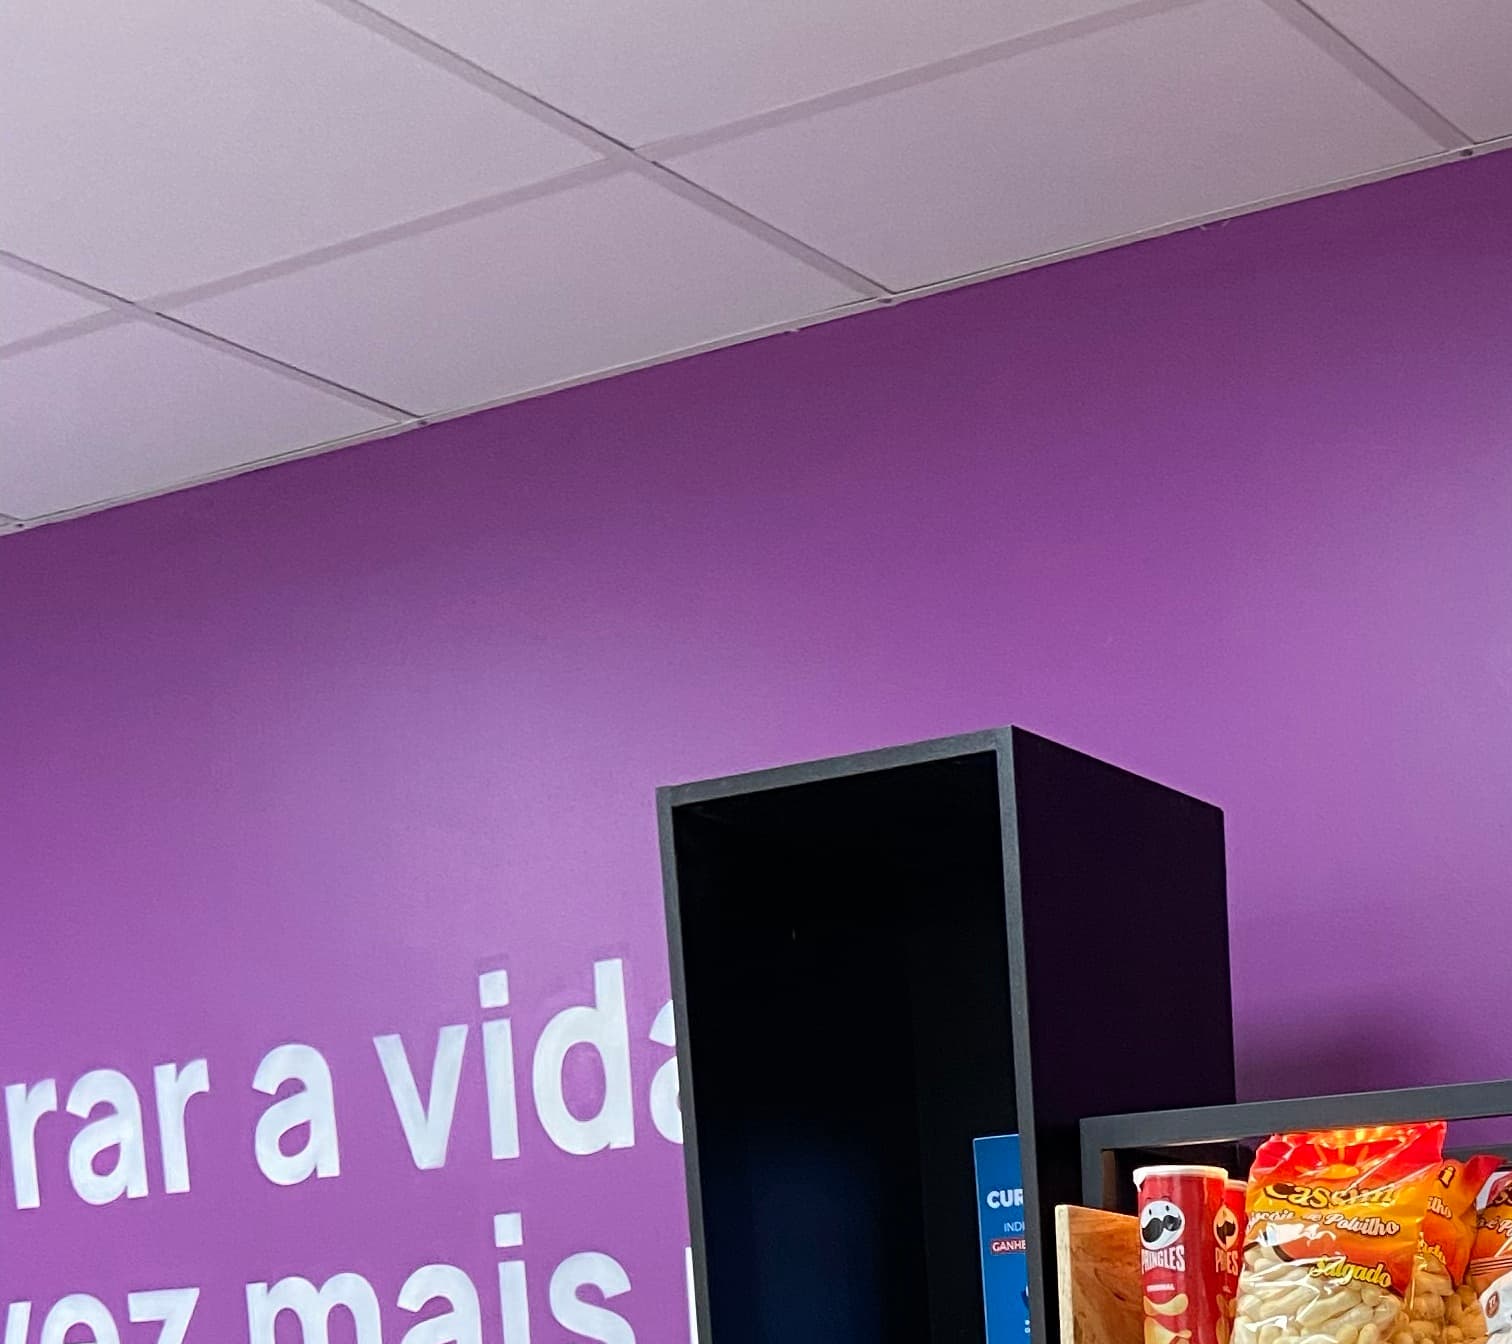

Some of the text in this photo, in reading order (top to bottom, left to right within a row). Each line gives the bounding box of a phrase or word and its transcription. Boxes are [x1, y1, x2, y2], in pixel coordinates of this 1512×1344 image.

[4, 1058, 210, 1209] rar
[252, 1043, 341, 1186] a
[1141, 1245, 1186, 1273] PRINGLES
